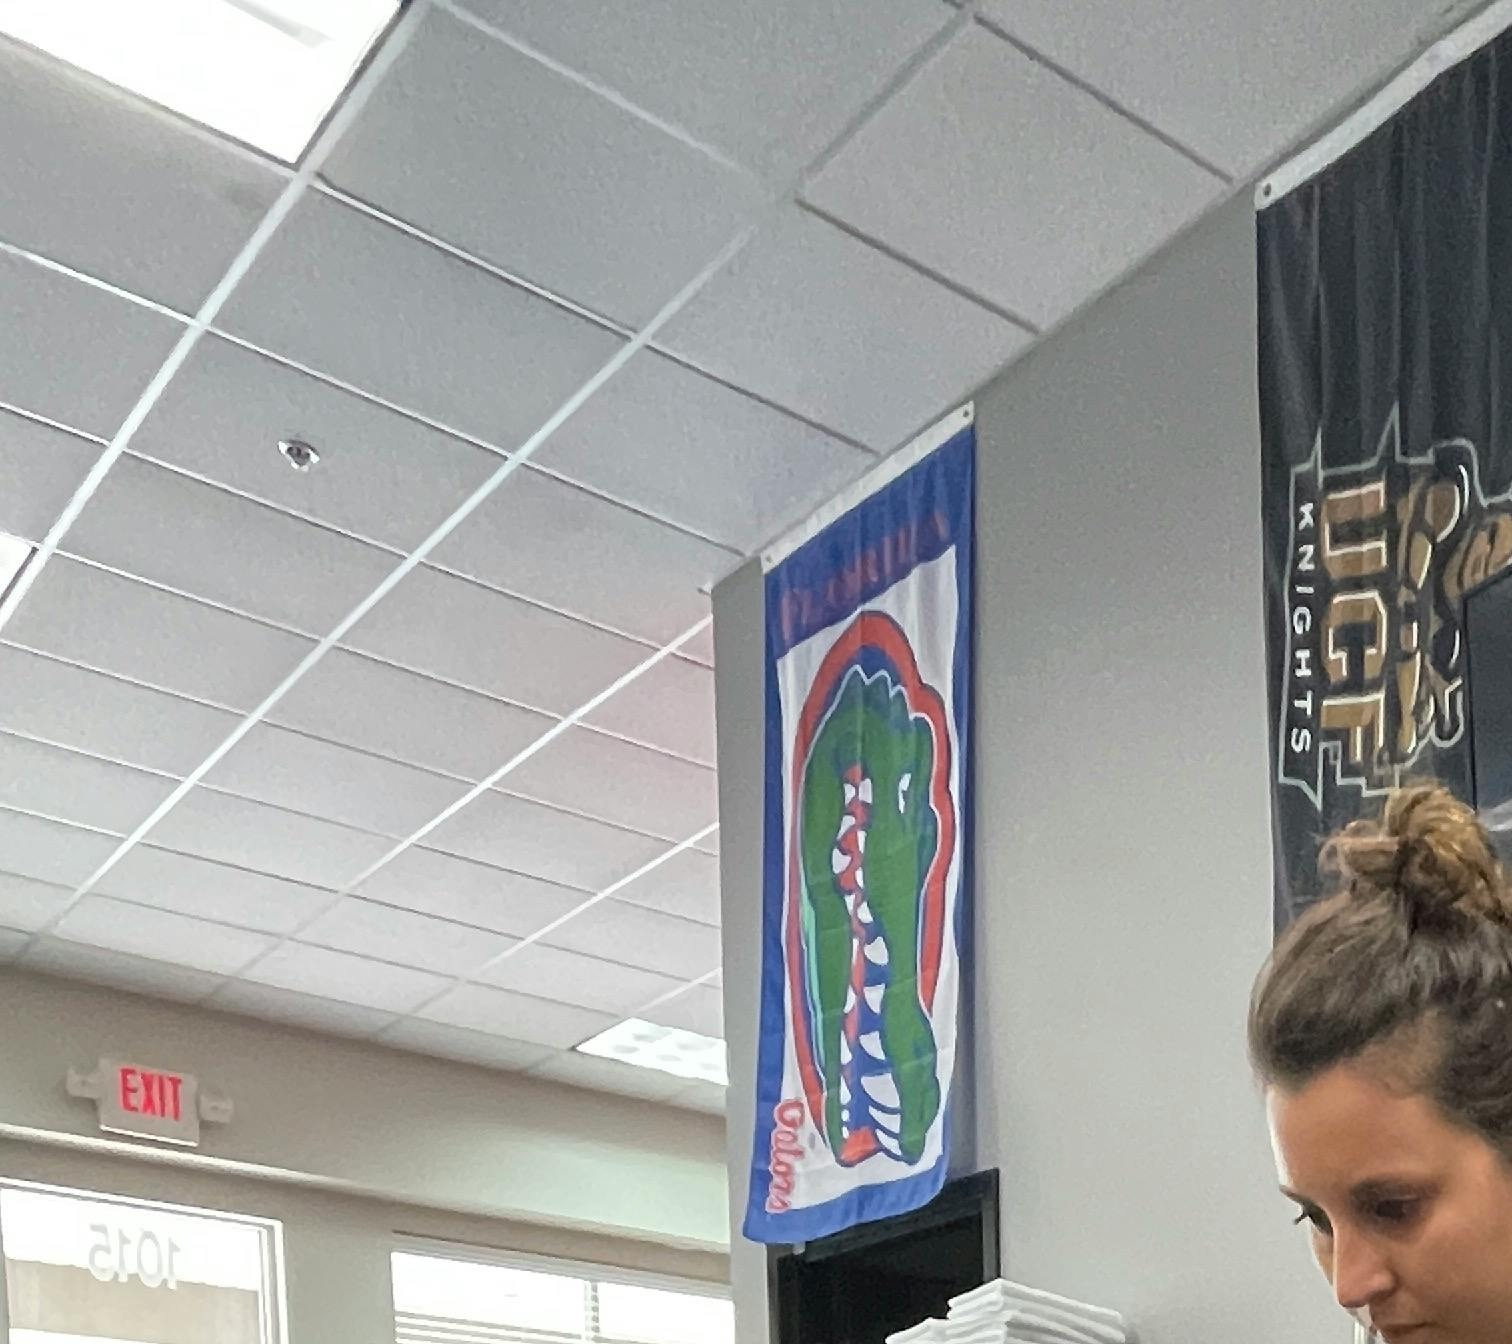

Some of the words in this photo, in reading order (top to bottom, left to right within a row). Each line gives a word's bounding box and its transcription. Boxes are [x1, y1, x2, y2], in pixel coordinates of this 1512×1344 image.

[1290, 502, 1315, 753] KNIGHTS
[119, 1067, 182, 1122] EXIT
[765, 1099, 805, 1213] Gators
